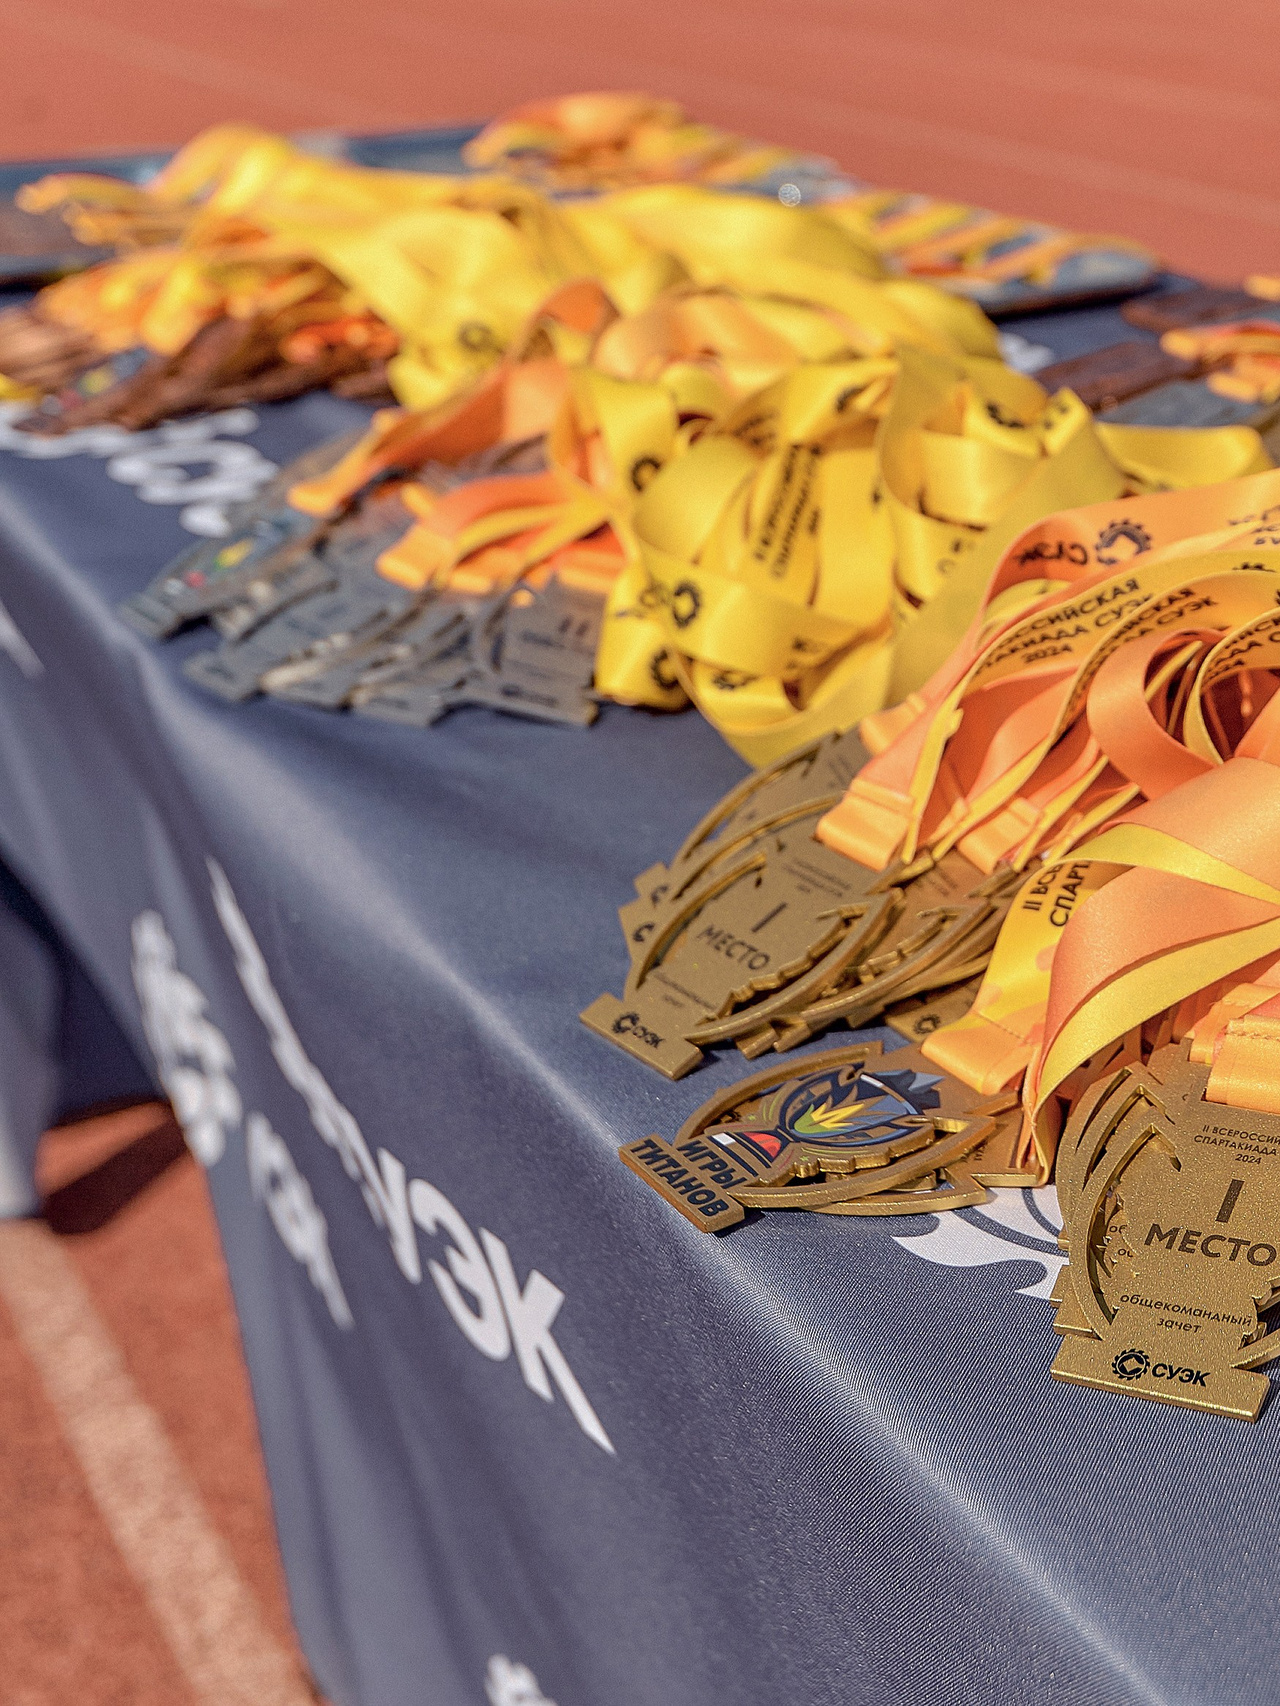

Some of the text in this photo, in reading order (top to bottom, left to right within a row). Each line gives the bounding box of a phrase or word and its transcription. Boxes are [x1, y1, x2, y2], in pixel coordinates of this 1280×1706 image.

[696, 923, 772, 971] МЕСТО
[1193, 1134, 1277, 1156] СПАРТАКИАДА
[1202, 1124, 1210, 1133] II
[676, 1139, 748, 1190] ИГРЫ
[1235, 1153, 1262, 1165] 2024
[630, 1138, 729, 1217] ТИТАНОВ
[1215, 1178, 1245, 1222] I
[1144, 1223, 1278, 1267] МЕСТО
[1119, 1293, 1254, 1327] общекомандный
[1157, 1318, 1202, 1334] зачет
[1152, 1363, 1211, 1388] СУЭК
